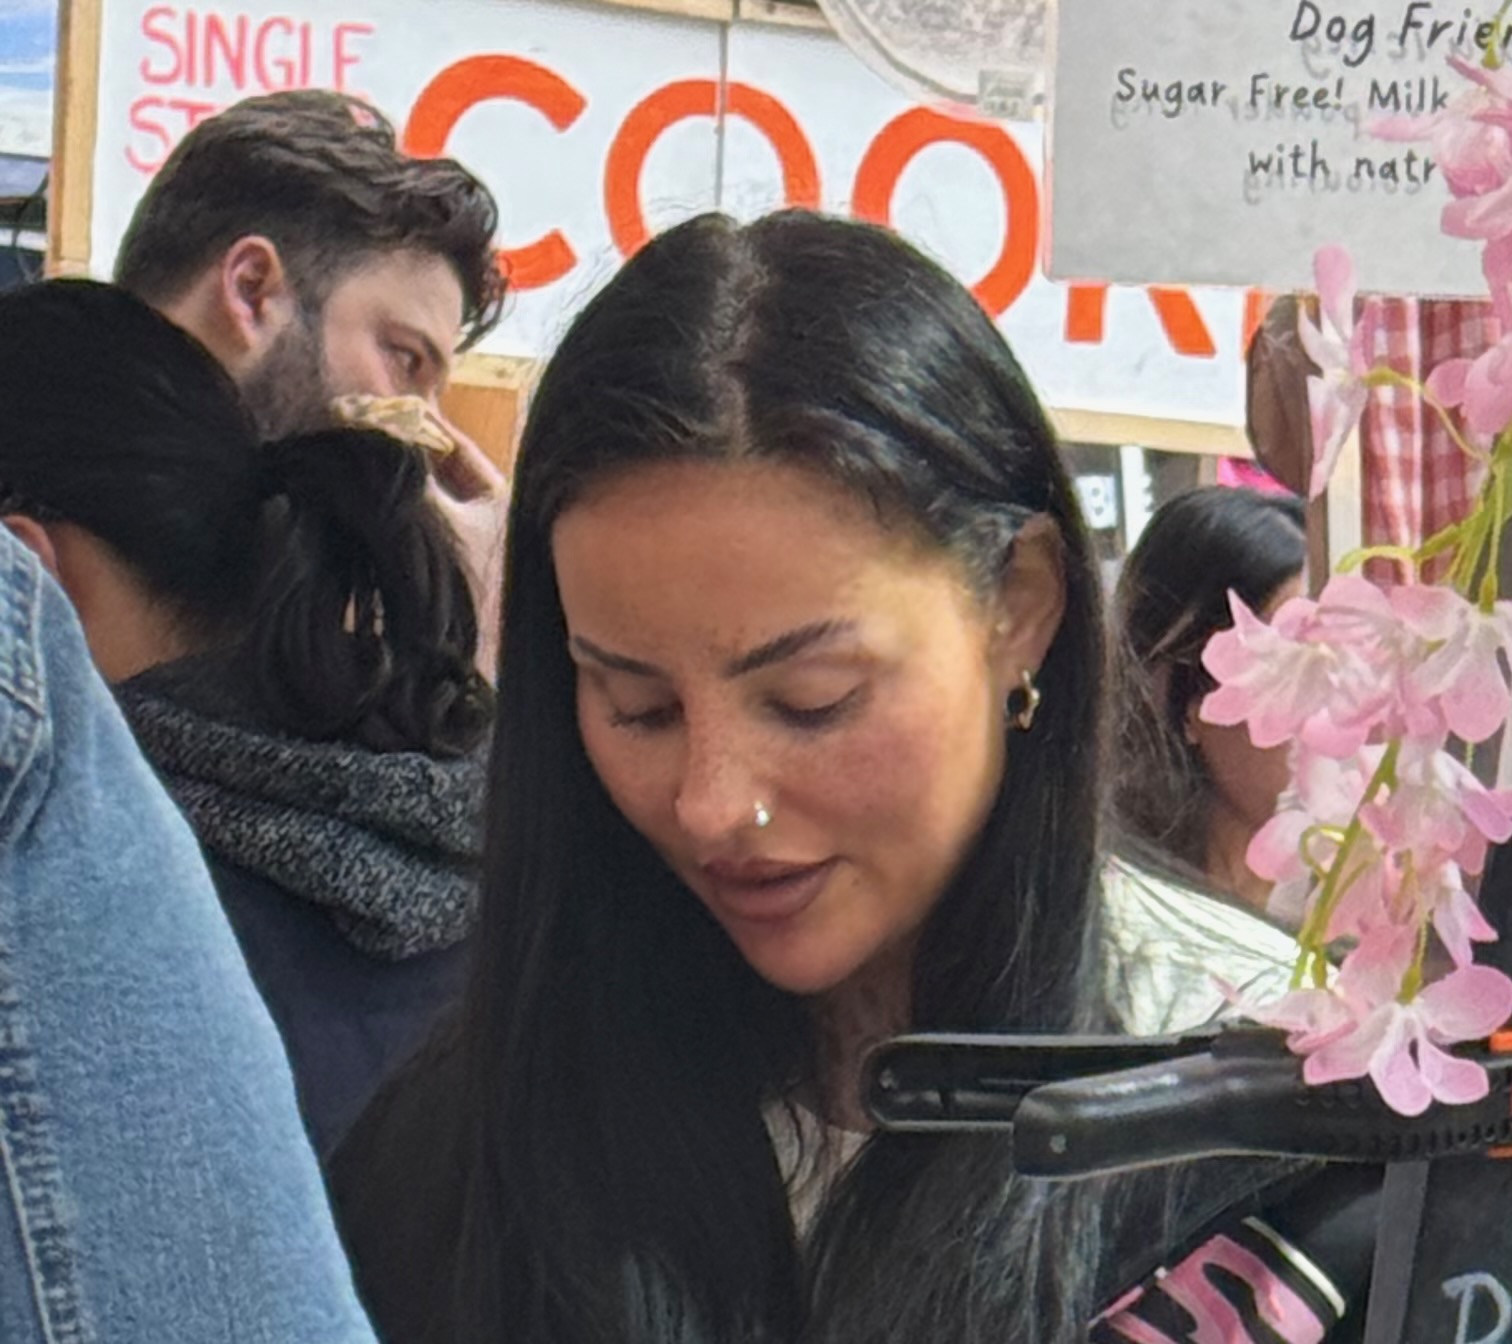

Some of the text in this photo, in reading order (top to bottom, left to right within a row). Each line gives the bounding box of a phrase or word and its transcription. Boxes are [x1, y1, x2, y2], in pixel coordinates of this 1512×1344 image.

[1289, 0, 1377, 68] Dog
[1115, 67, 1450, 119] Sugar Free! Milk
[1248, 139, 1330, 181] with
